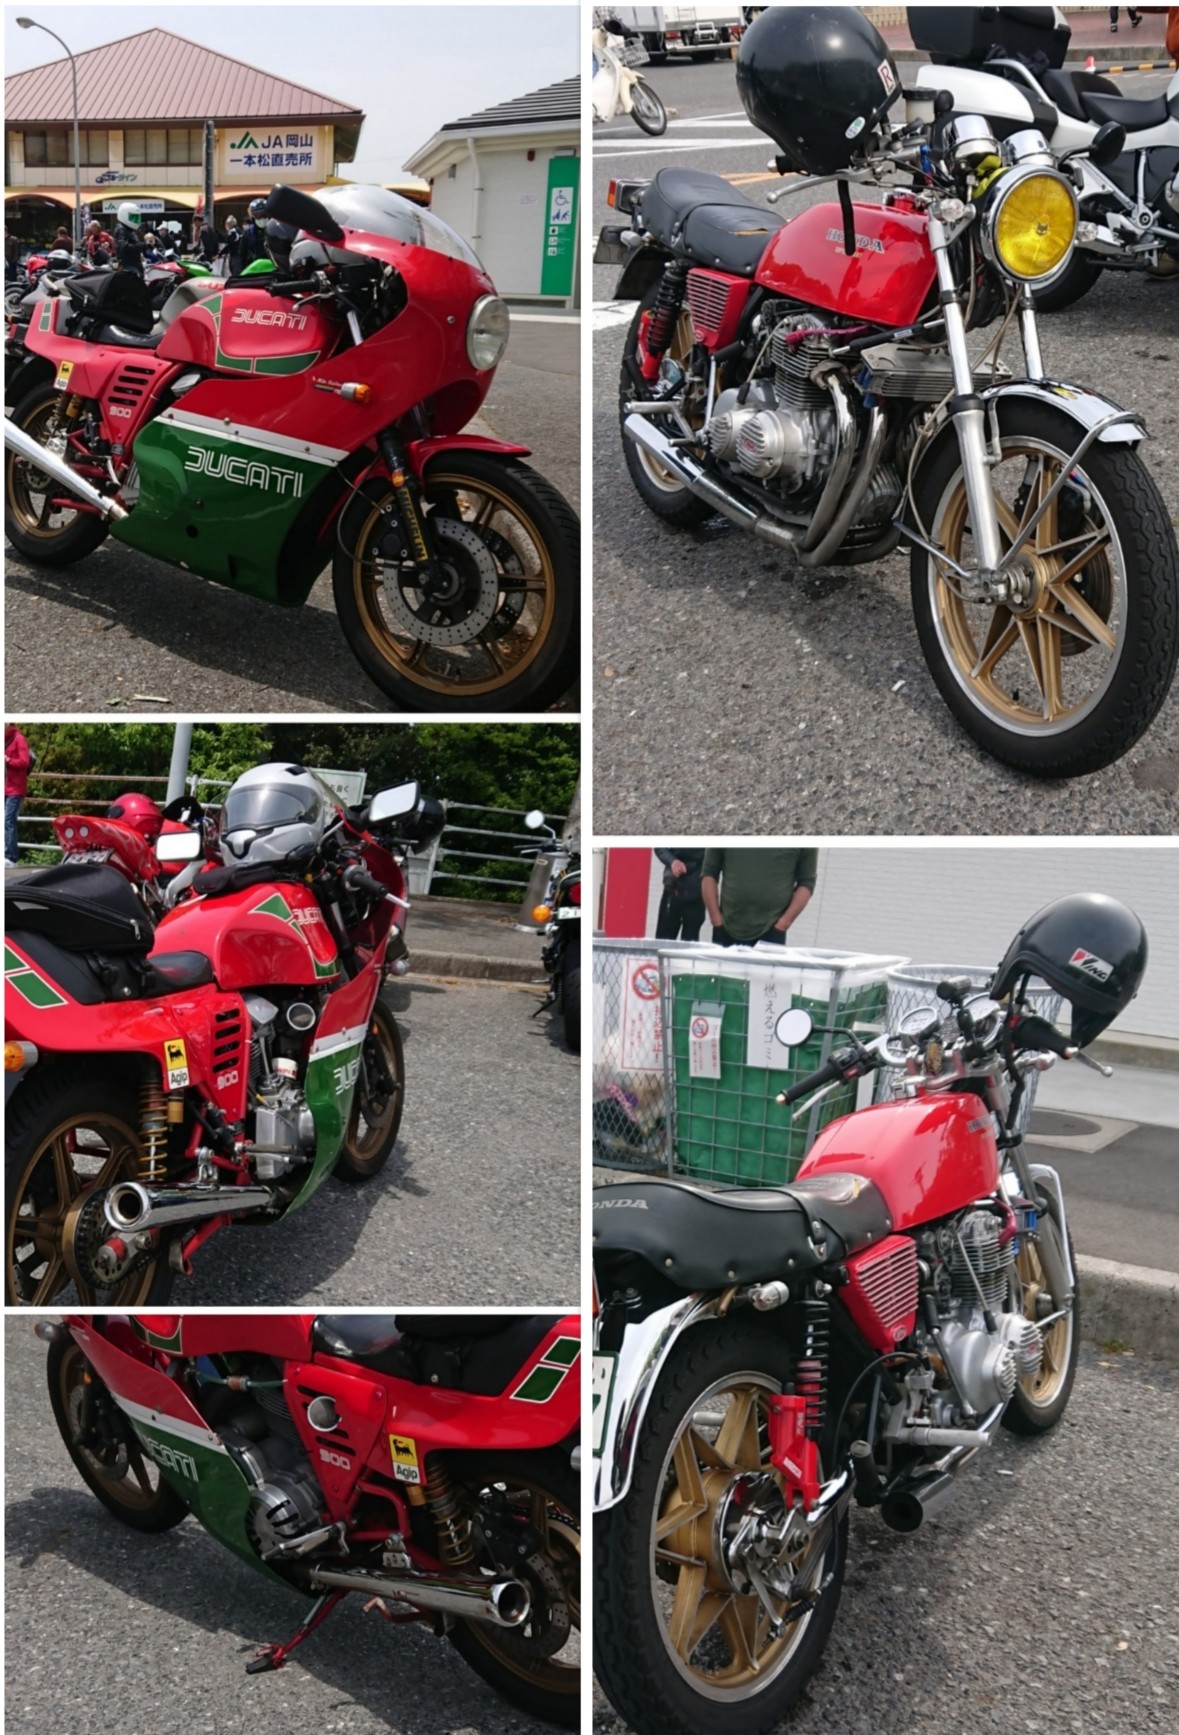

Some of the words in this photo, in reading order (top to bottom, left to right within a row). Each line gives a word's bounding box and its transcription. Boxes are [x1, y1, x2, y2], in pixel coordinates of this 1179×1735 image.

[229, 152, 313, 167] 一本松直売所
[231, 308, 308, 331] DUCATI
[184, 445, 304, 498] DUCATI
[170, 1070, 188, 1085] Agip
[216, 1070, 239, 1091] 900
[319, 1448, 351, 1471] 900
[396, 1464, 418, 1480] Agip
